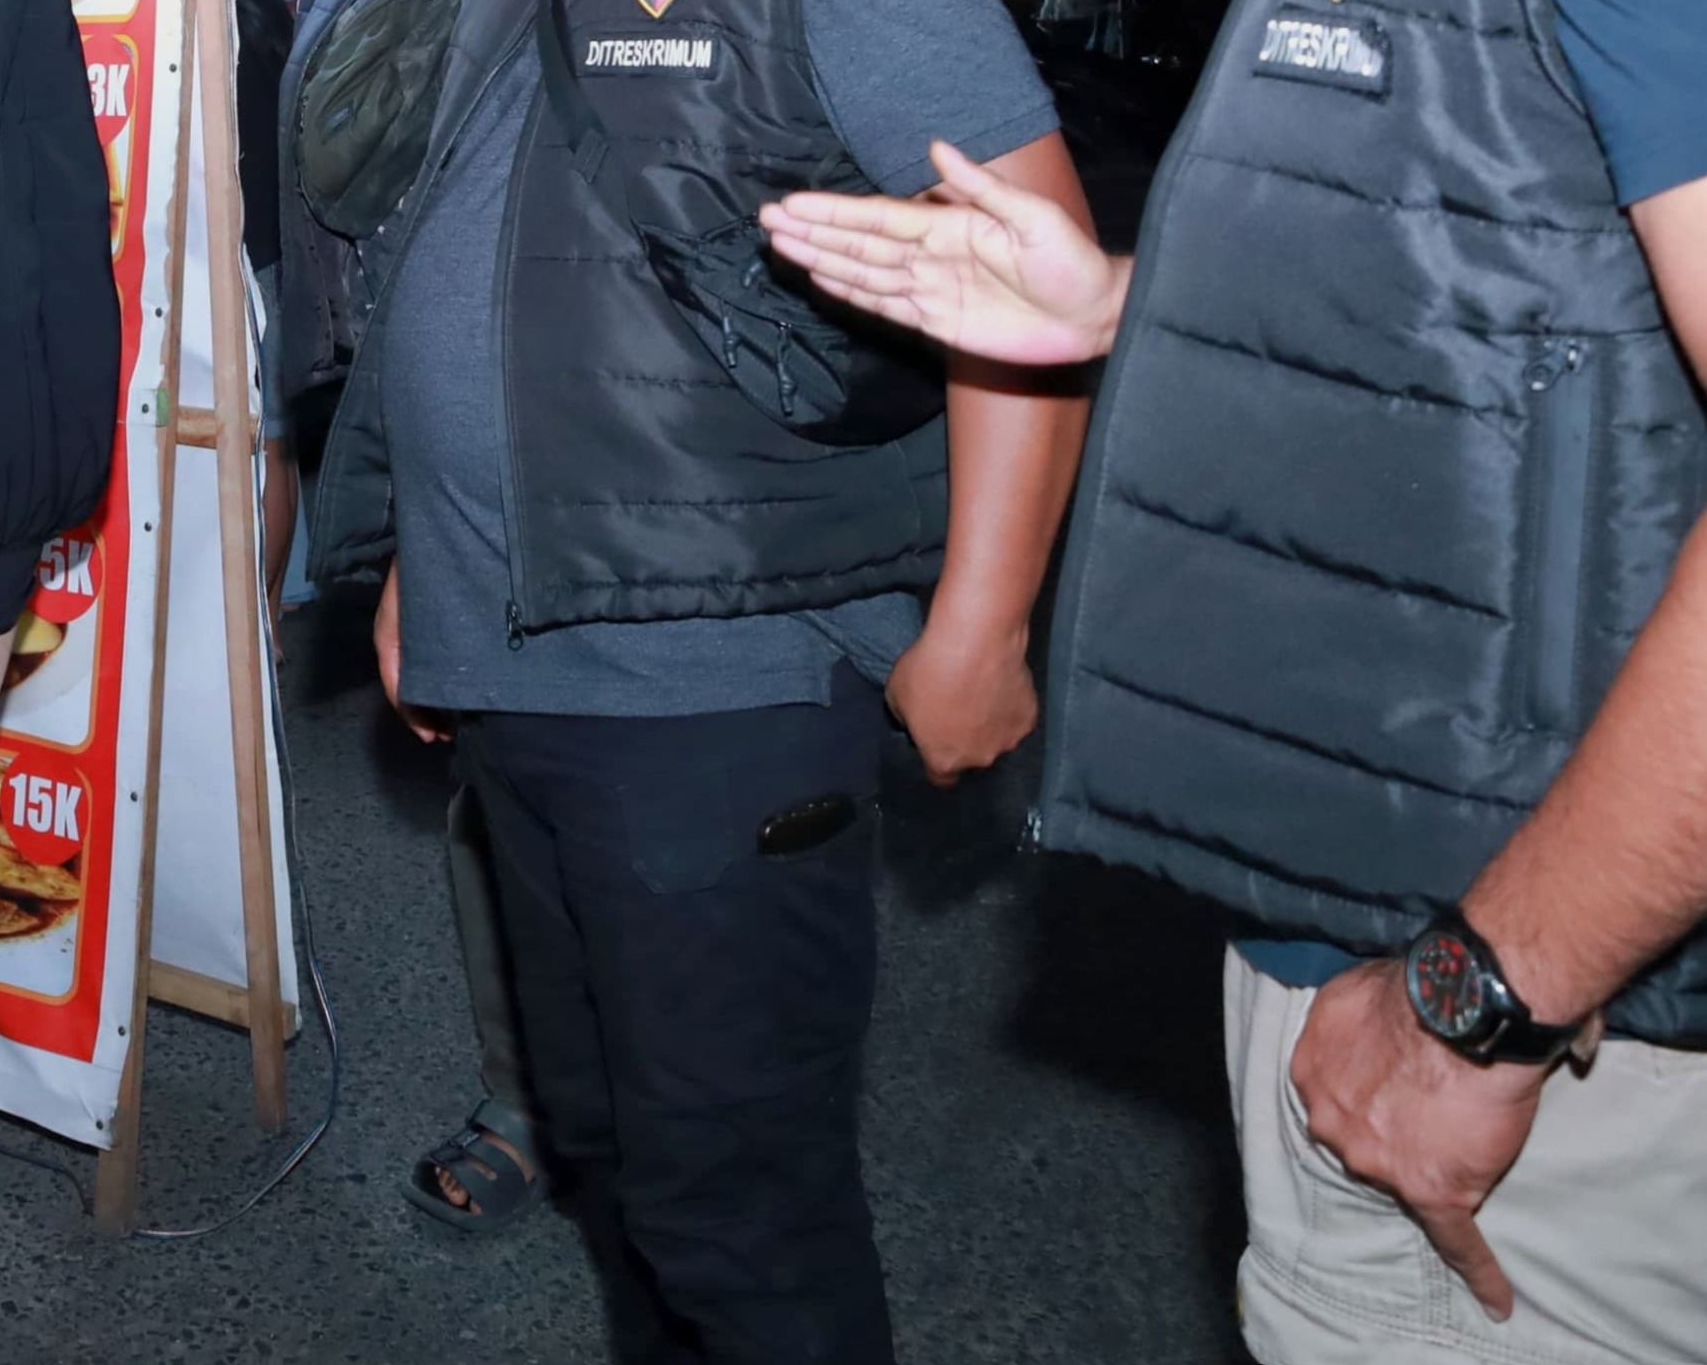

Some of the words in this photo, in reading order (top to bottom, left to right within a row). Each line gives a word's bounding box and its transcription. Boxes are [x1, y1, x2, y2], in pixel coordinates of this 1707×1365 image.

[585, 39, 712, 68] DITRESKRIMUM
[87, 63, 130, 117] 3K
[39, 537, 95, 597] 5K
[9, 772, 83, 842] 15K
